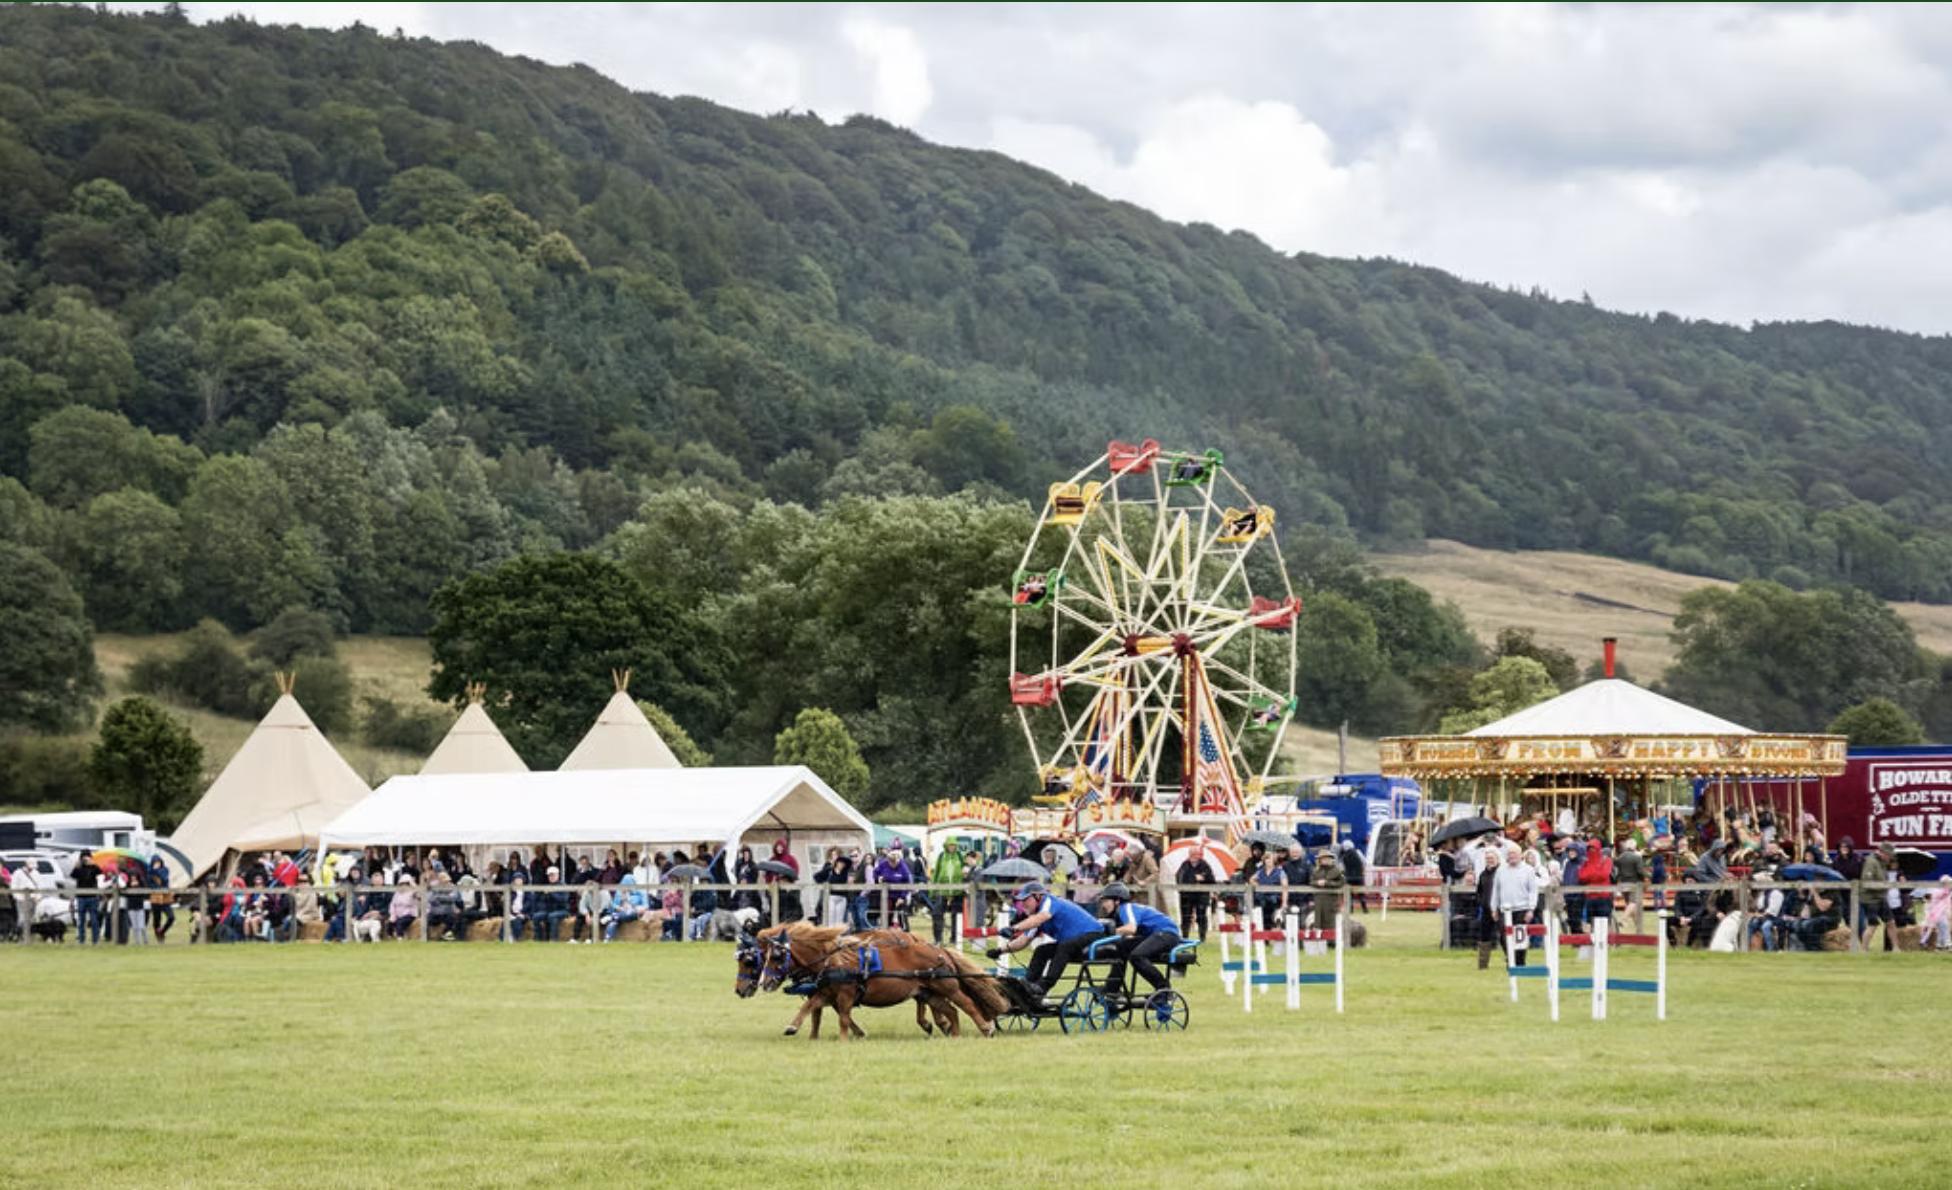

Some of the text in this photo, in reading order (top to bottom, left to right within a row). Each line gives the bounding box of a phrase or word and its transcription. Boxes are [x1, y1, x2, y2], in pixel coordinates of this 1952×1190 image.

[1635, 740, 1711, 758] HAPPY
[1889, 790, 1930, 806] OLDE
[928, 796, 1154, 825] ATLANTIC STAR
[1879, 814, 1925, 837] FUN
[1515, 927, 1526, 944] D
